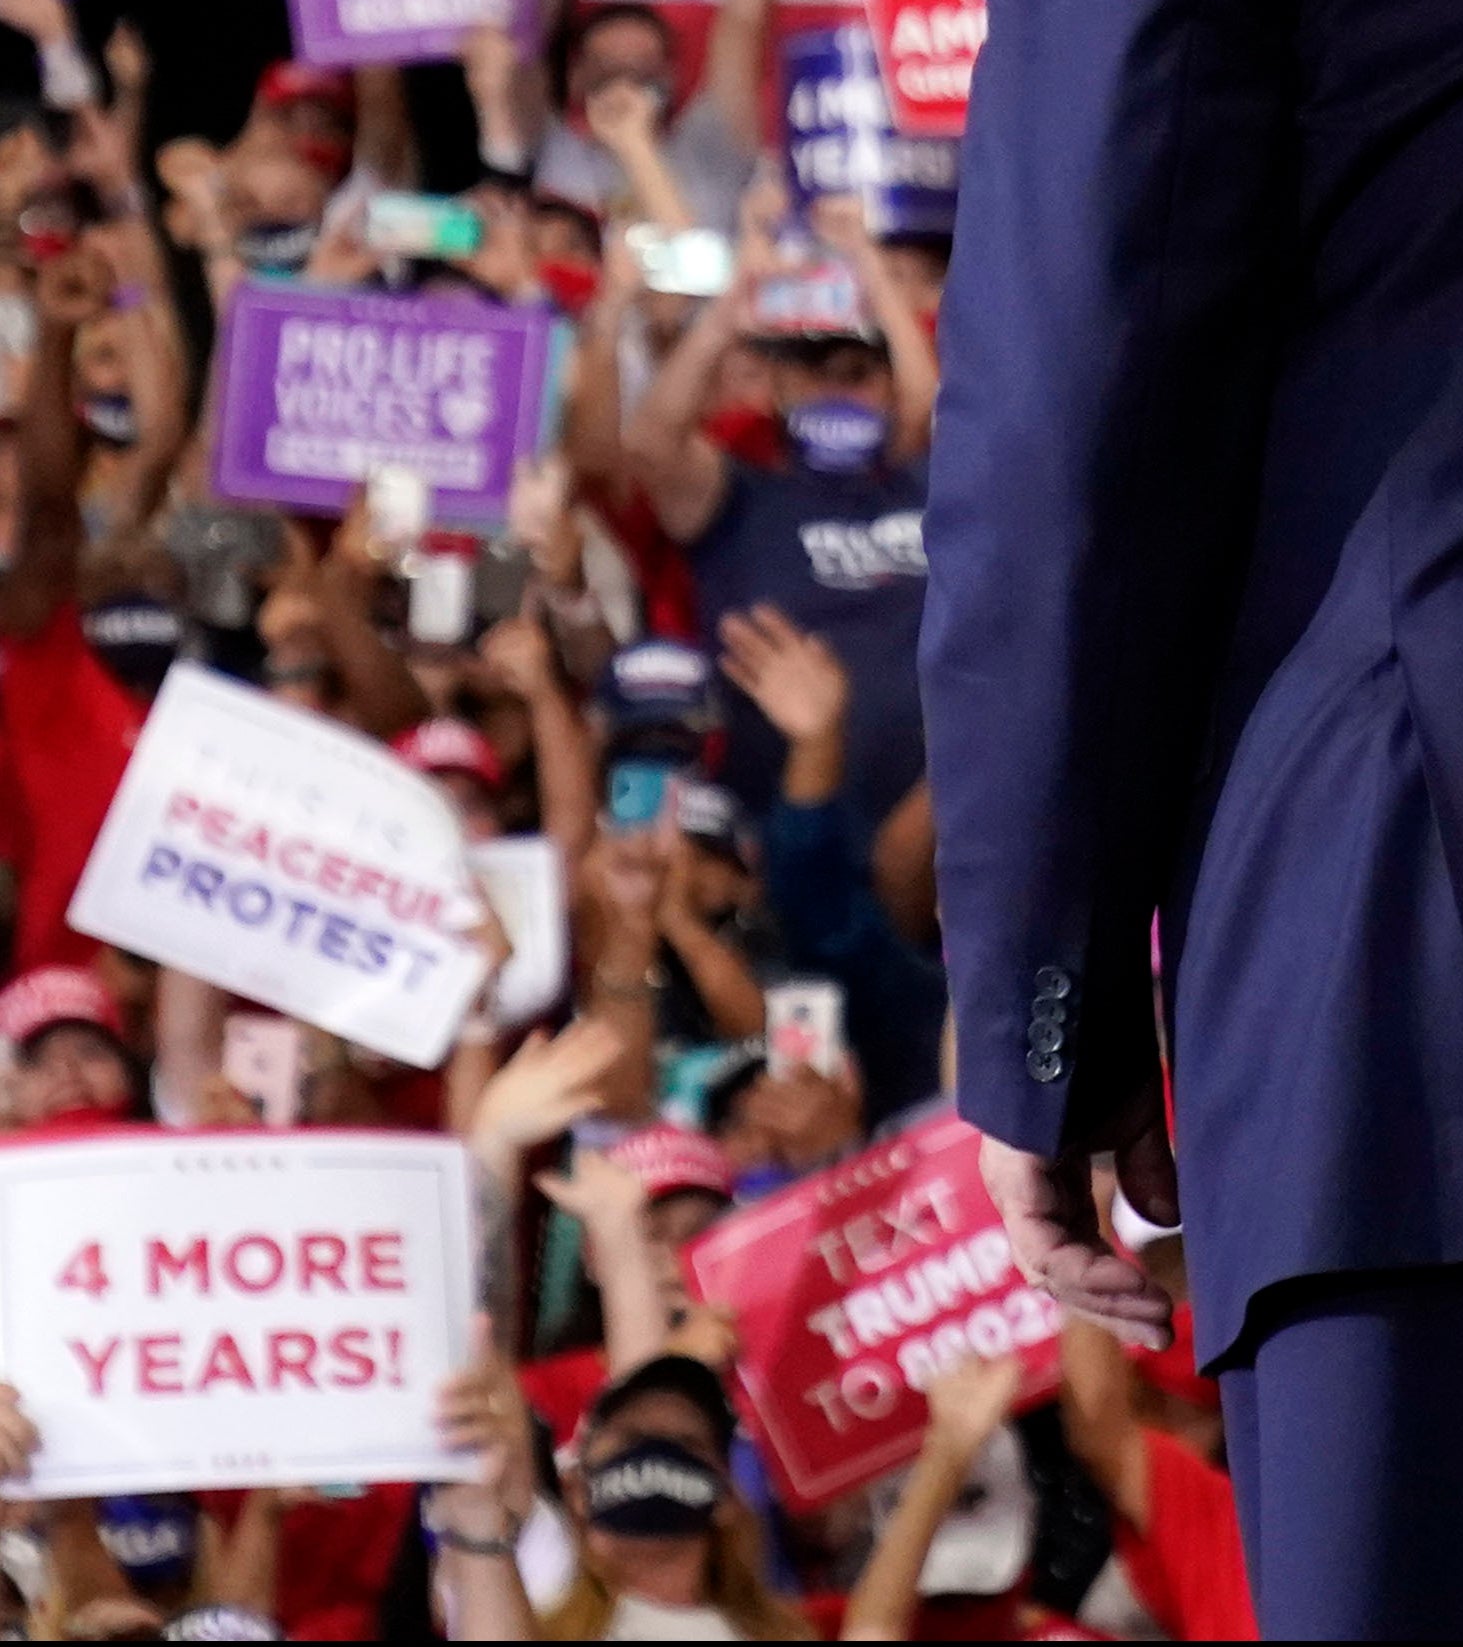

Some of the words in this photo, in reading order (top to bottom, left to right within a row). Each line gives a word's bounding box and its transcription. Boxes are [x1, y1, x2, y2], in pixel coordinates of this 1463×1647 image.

[278, 318, 495, 388] PRO-LIFE
[165, 789, 456, 936] PEACEFUL
[140, 842, 440, 997] PROTEST
[55, 1237, 112, 1302] 4
[143, 1229, 408, 1300] MORE
[816, 1176, 958, 1286] TEXT
[806, 1226, 1010, 1360] TRUMP
[65, 1326, 407, 1401] YEARS!
[804, 1358, 898, 1435] TO
